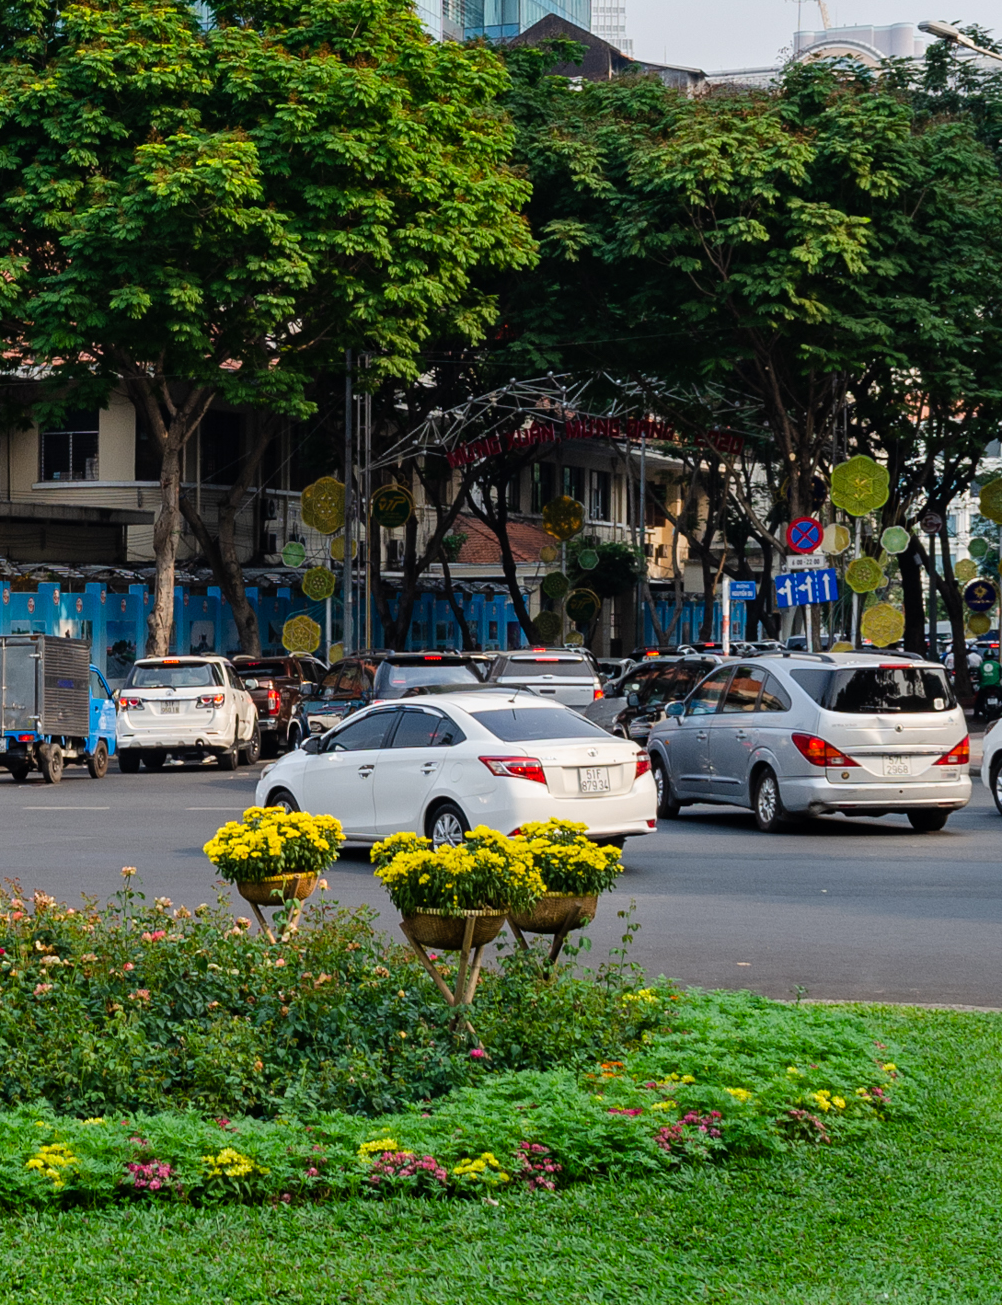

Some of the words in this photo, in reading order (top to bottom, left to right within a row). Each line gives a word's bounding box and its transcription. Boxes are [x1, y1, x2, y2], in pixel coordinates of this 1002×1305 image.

[888, 756, 905, 764] 57L
[886, 766, 908, 774] 2968
[586, 769, 602, 780] 51F
